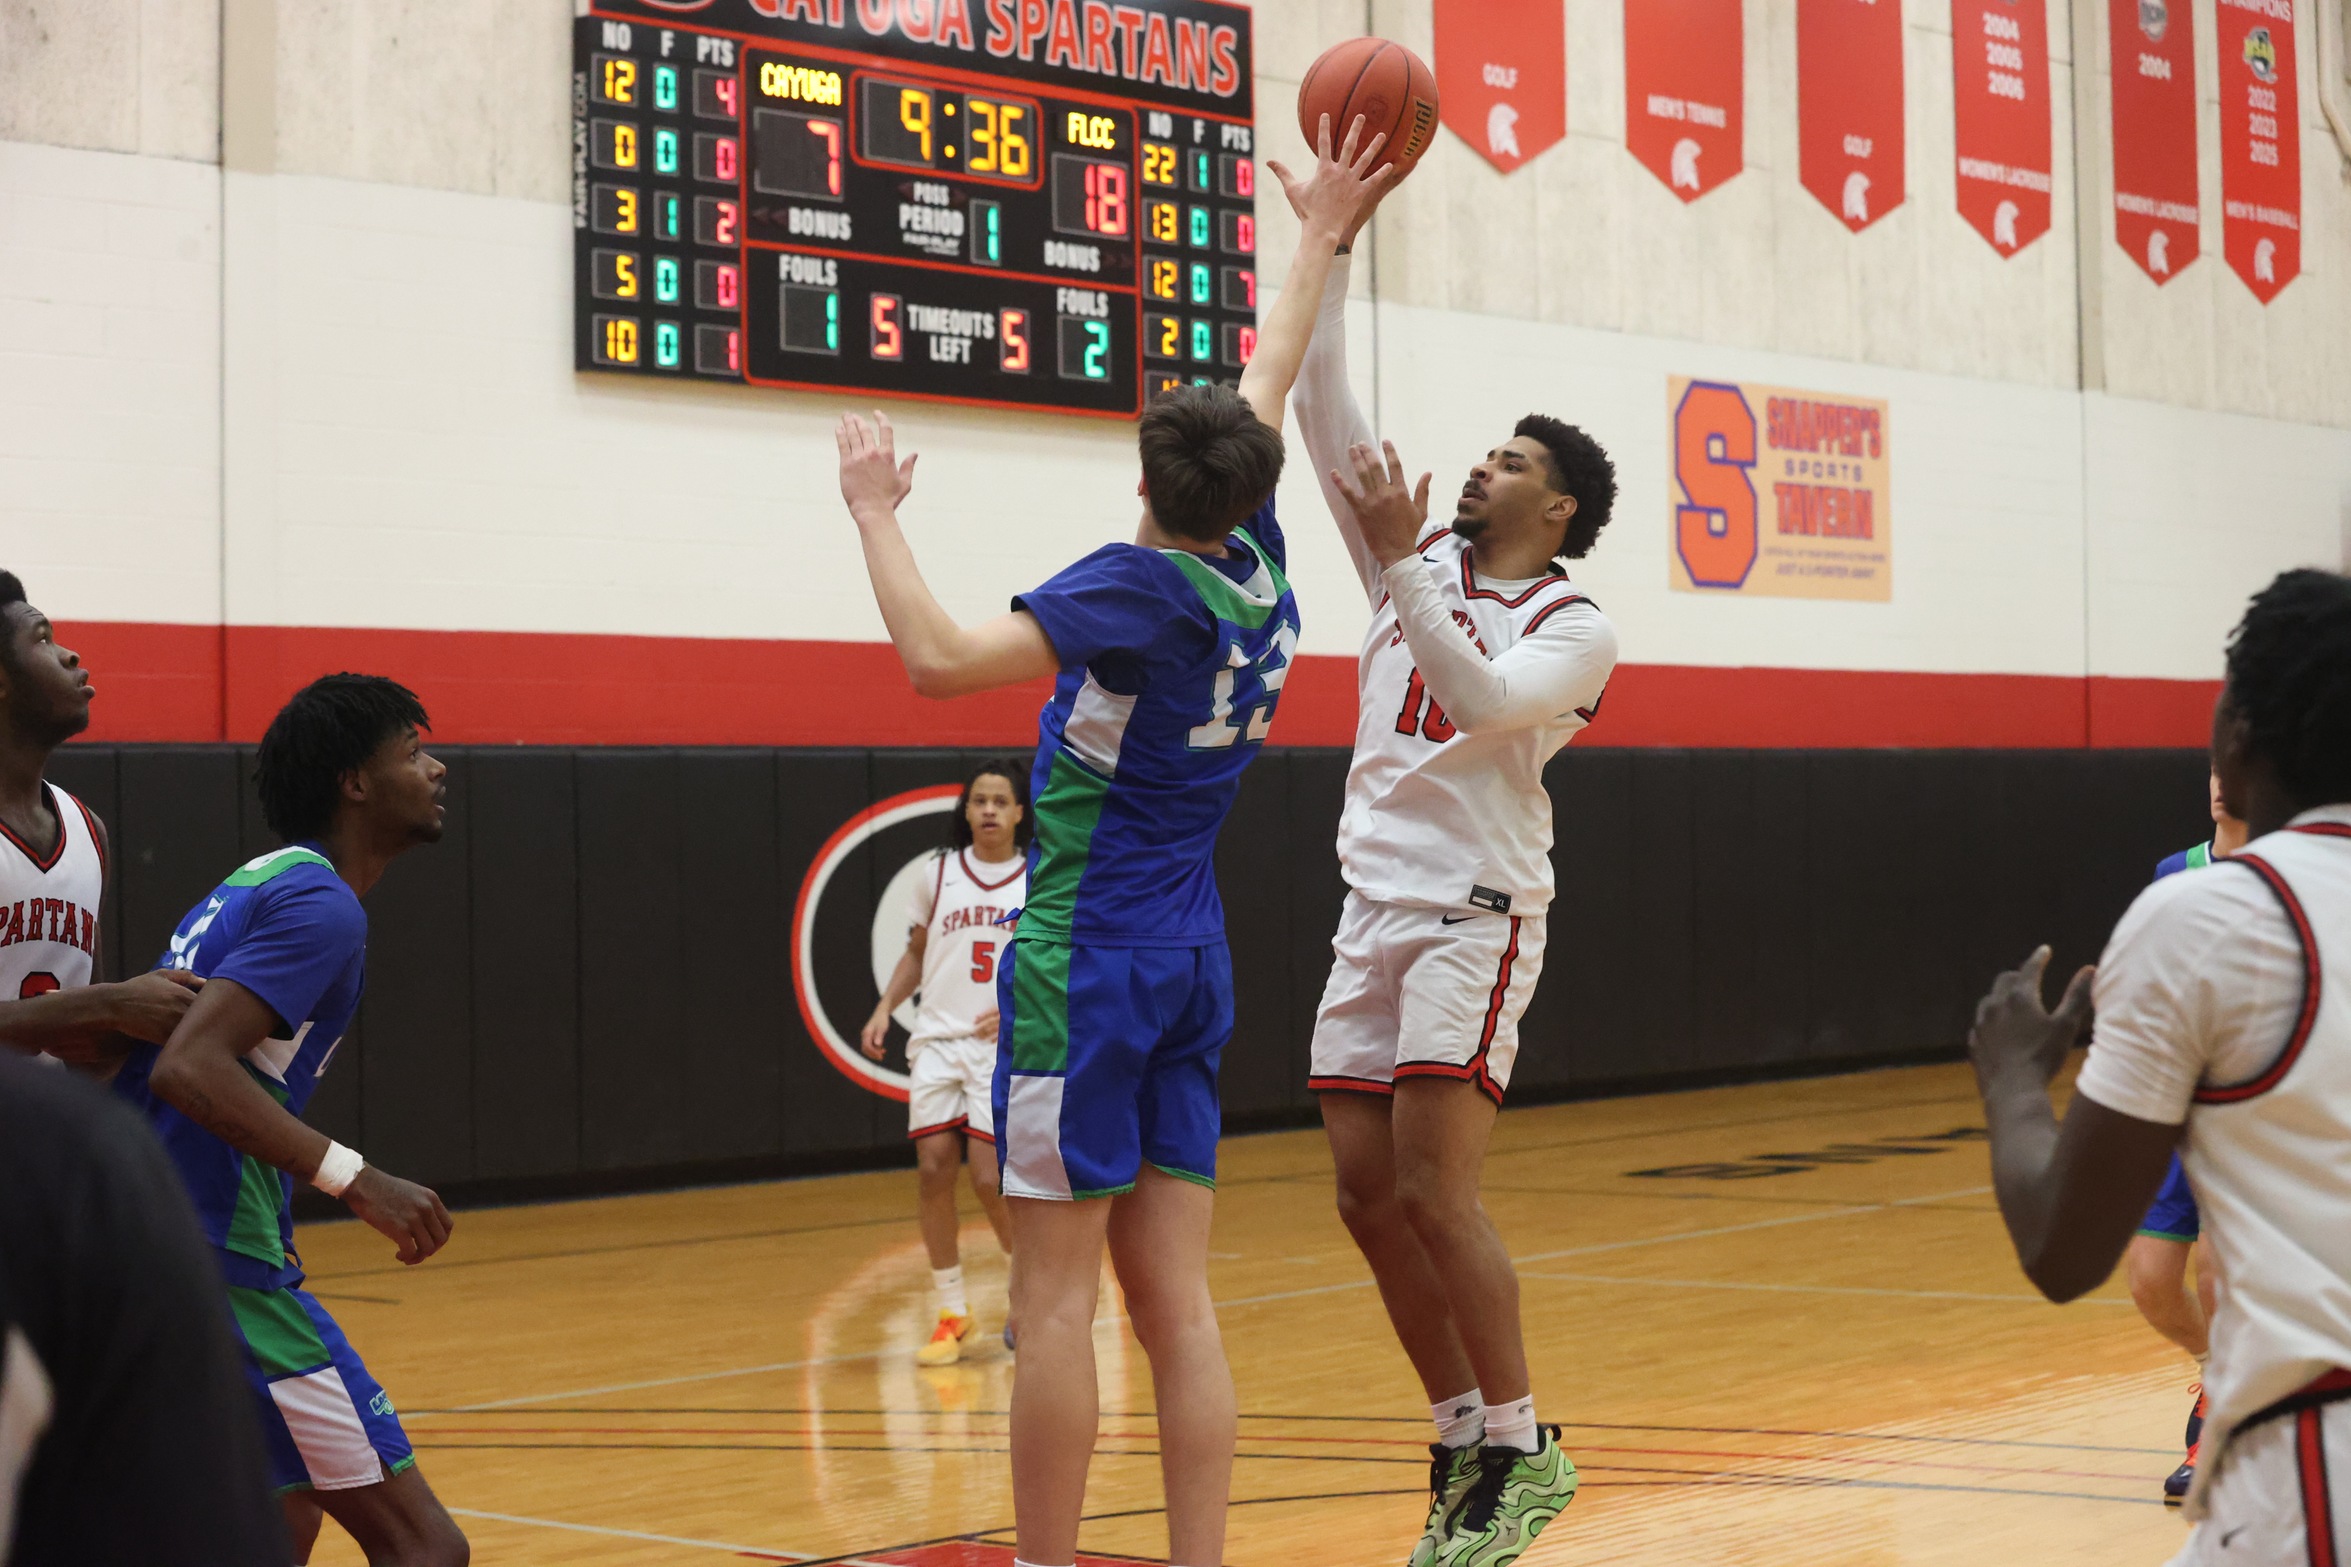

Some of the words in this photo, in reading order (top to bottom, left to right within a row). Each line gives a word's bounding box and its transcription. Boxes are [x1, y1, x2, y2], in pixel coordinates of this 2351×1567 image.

[602, 20, 632, 51] NO
[660, 29, 675, 58] F
[697, 35, 735, 68] PTS
[751, 0, 976, 51] UGA
[985, 0, 1240, 98] SPARTANS
[605, 60, 637, 103] 12
[655, 65, 677, 109] 0
[716, 78, 736, 117] 4
[760, 62, 842, 105] CAYUGA
[614, 124, 637, 167] 0
[656, 129, 677, 172] 0
[716, 138, 736, 180] 0
[901, 88, 1031, 176] 9:36
[1067, 111, 1115, 149] FLCC
[1148, 111, 1173, 139] NO
[1192, 119, 1205, 143] F
[1221, 124, 1251, 152] PTS
[806, 119, 840, 195] 7
[1143, 143, 1175, 184] 22
[1198, 153, 1208, 188] 1
[1236, 158, 1254, 196] 0
[615, 189, 637, 232] 3
[667, 197, 677, 236] 1
[716, 201, 737, 244] 2
[788, 207, 852, 240] BONUS
[899, 203, 964, 237] PERIOD
[1084, 163, 1127, 236] 18
[987, 206, 998, 261] 1
[1153, 203, 1178, 241] 13
[1191, 208, 1209, 247] 0
[1237, 214, 1254, 253] 0
[616, 254, 637, 297] 5
[656, 258, 678, 302] 0
[717, 265, 738, 307] 0
[779, 254, 838, 286] FOULS
[1044, 240, 1100, 272] BONUS
[1057, 287, 1109, 317] FOULS
[1153, 260, 1177, 299] 12
[1191, 264, 1209, 303] 0
[1239, 271, 1255, 308] 7
[606, 319, 638, 363] 10
[657, 323, 678, 366] 0
[728, 332, 739, 370] 1
[826, 293, 838, 350] 1
[872, 296, 900, 357] 5
[907, 304, 995, 340] TIMEOUTS
[1001, 311, 1028, 370] 5
[1161, 317, 1179, 356] 2
[1193, 321, 1210, 360] 0
[930, 337, 972, 364] LEFT
[1084, 320, 1108, 378] 2
[1784, 458, 1863, 483] SPORTS
[1773, 482, 1874, 541] TAVERN
[1495, 897, 1506, 908] XL
[970, 940, 996, 984] 5
